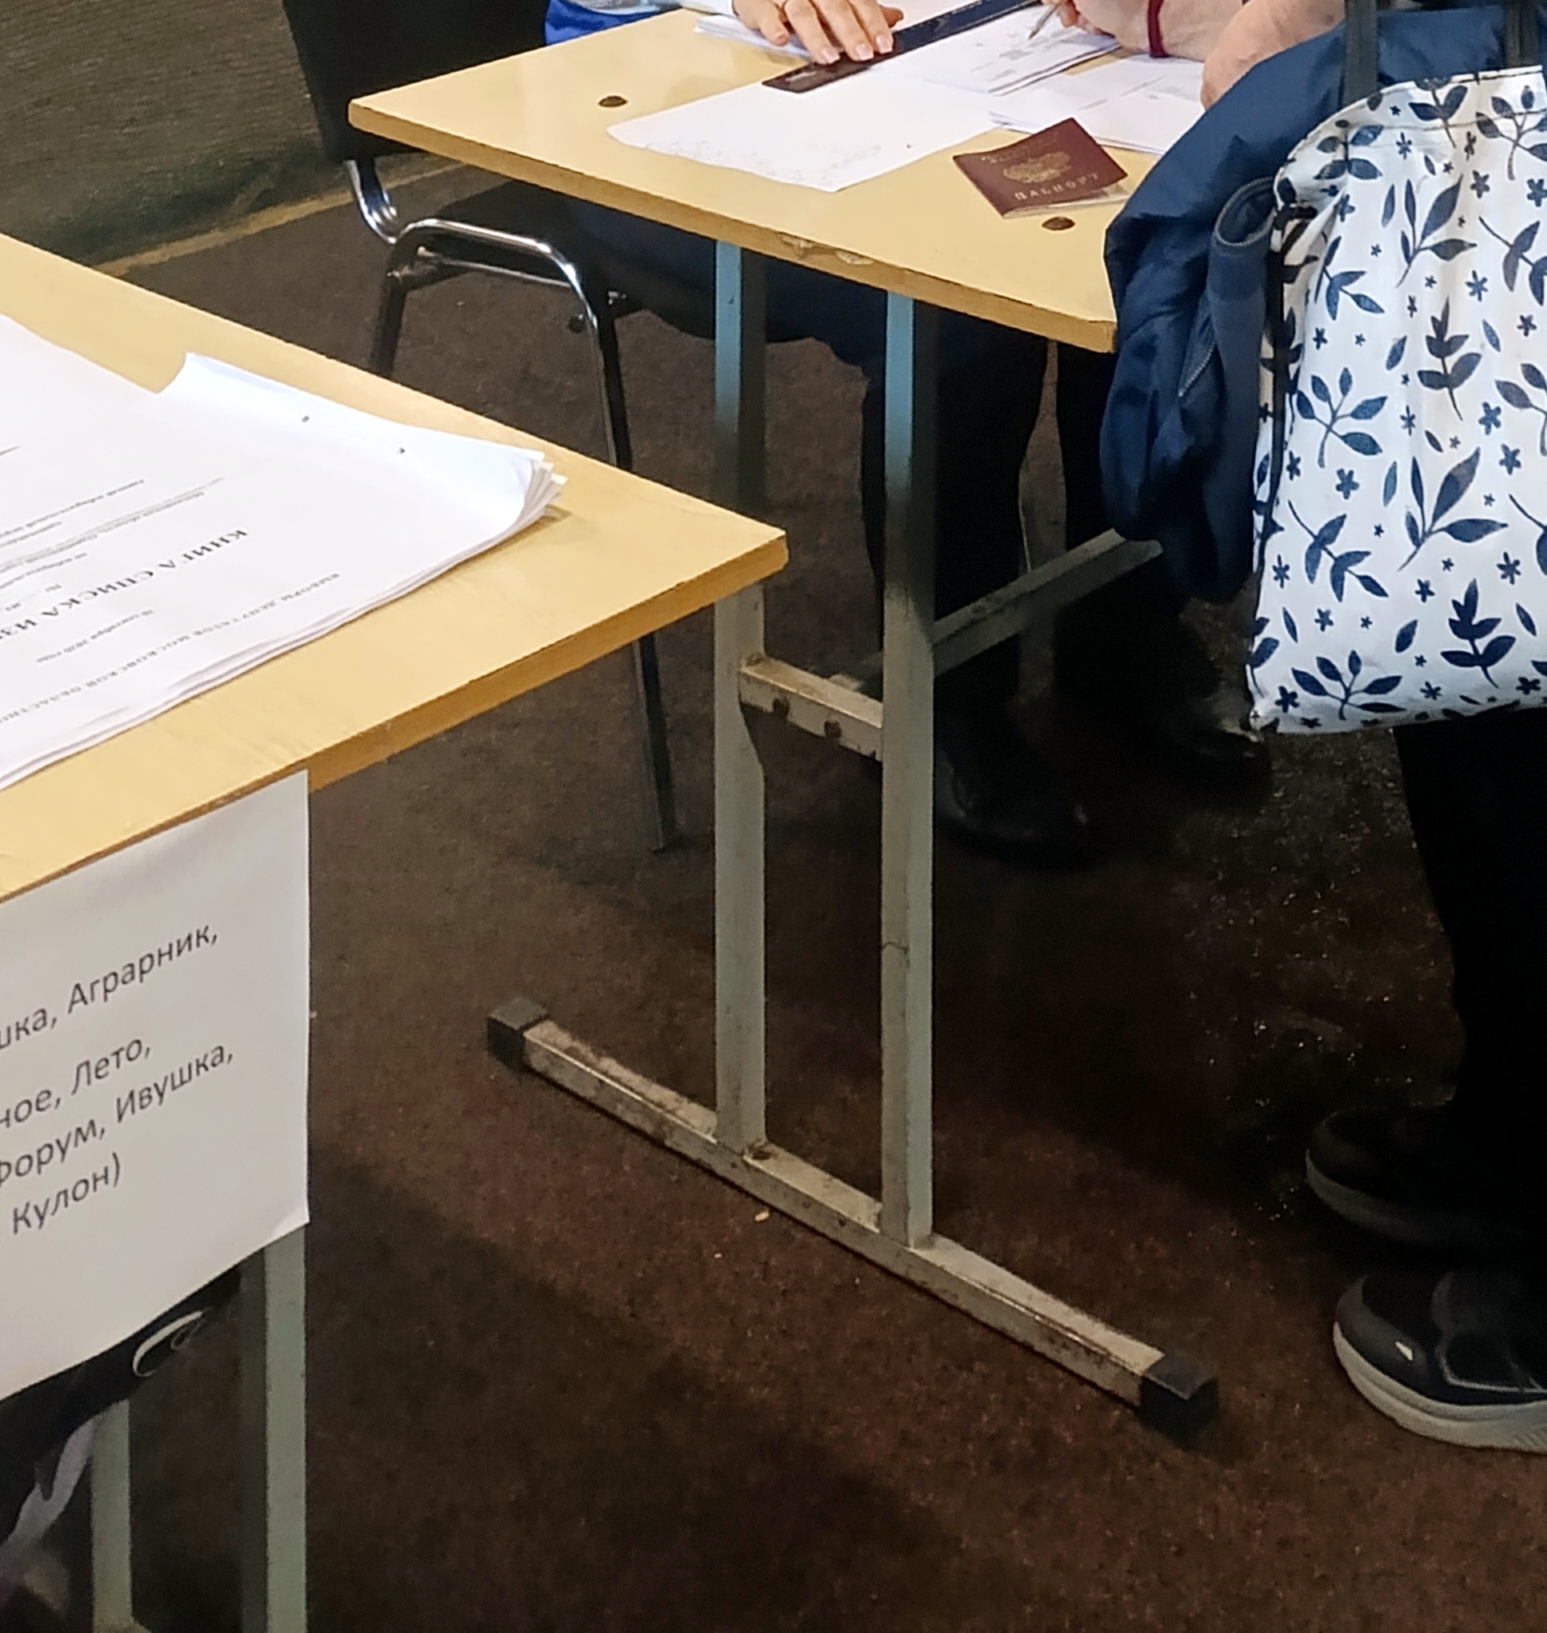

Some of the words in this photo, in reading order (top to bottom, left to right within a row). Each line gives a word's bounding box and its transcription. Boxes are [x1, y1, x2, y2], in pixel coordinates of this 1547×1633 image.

[1014, 172, 1099, 200] ПАСПОРТ
[157, 528, 248, 570] КНИГА
[41, 569, 155, 617] СПИСКА
[67, 923, 220, 1015] Аграрник,
[70, 1035, 152, 1096] Лето,
[114, 1042, 235, 1124] Ивушка,
[11, 1151, 123, 1235] Кулон)
